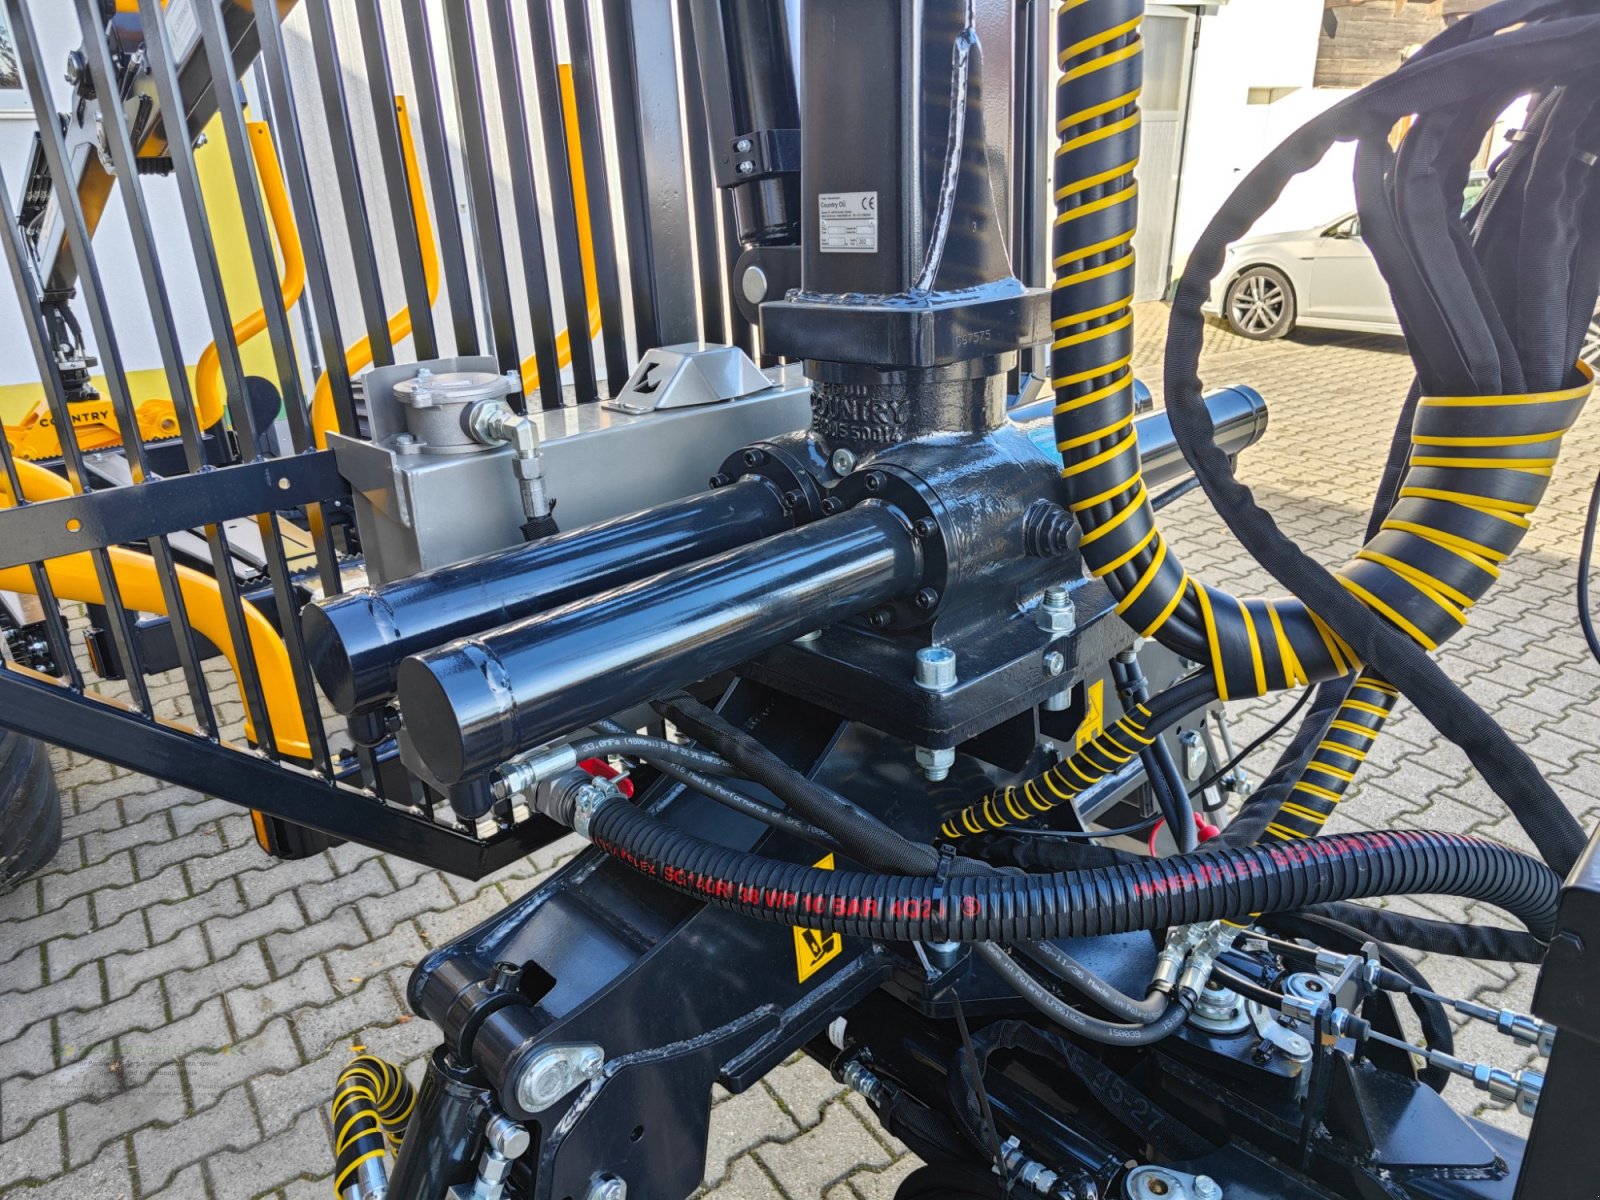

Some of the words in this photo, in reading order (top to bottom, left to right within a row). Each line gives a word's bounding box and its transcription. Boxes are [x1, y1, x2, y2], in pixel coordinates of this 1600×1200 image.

[715, 785, 768, 815] Performance
[832, 895, 879, 918] BAR
[1016, 969, 1042, 999] Poland
